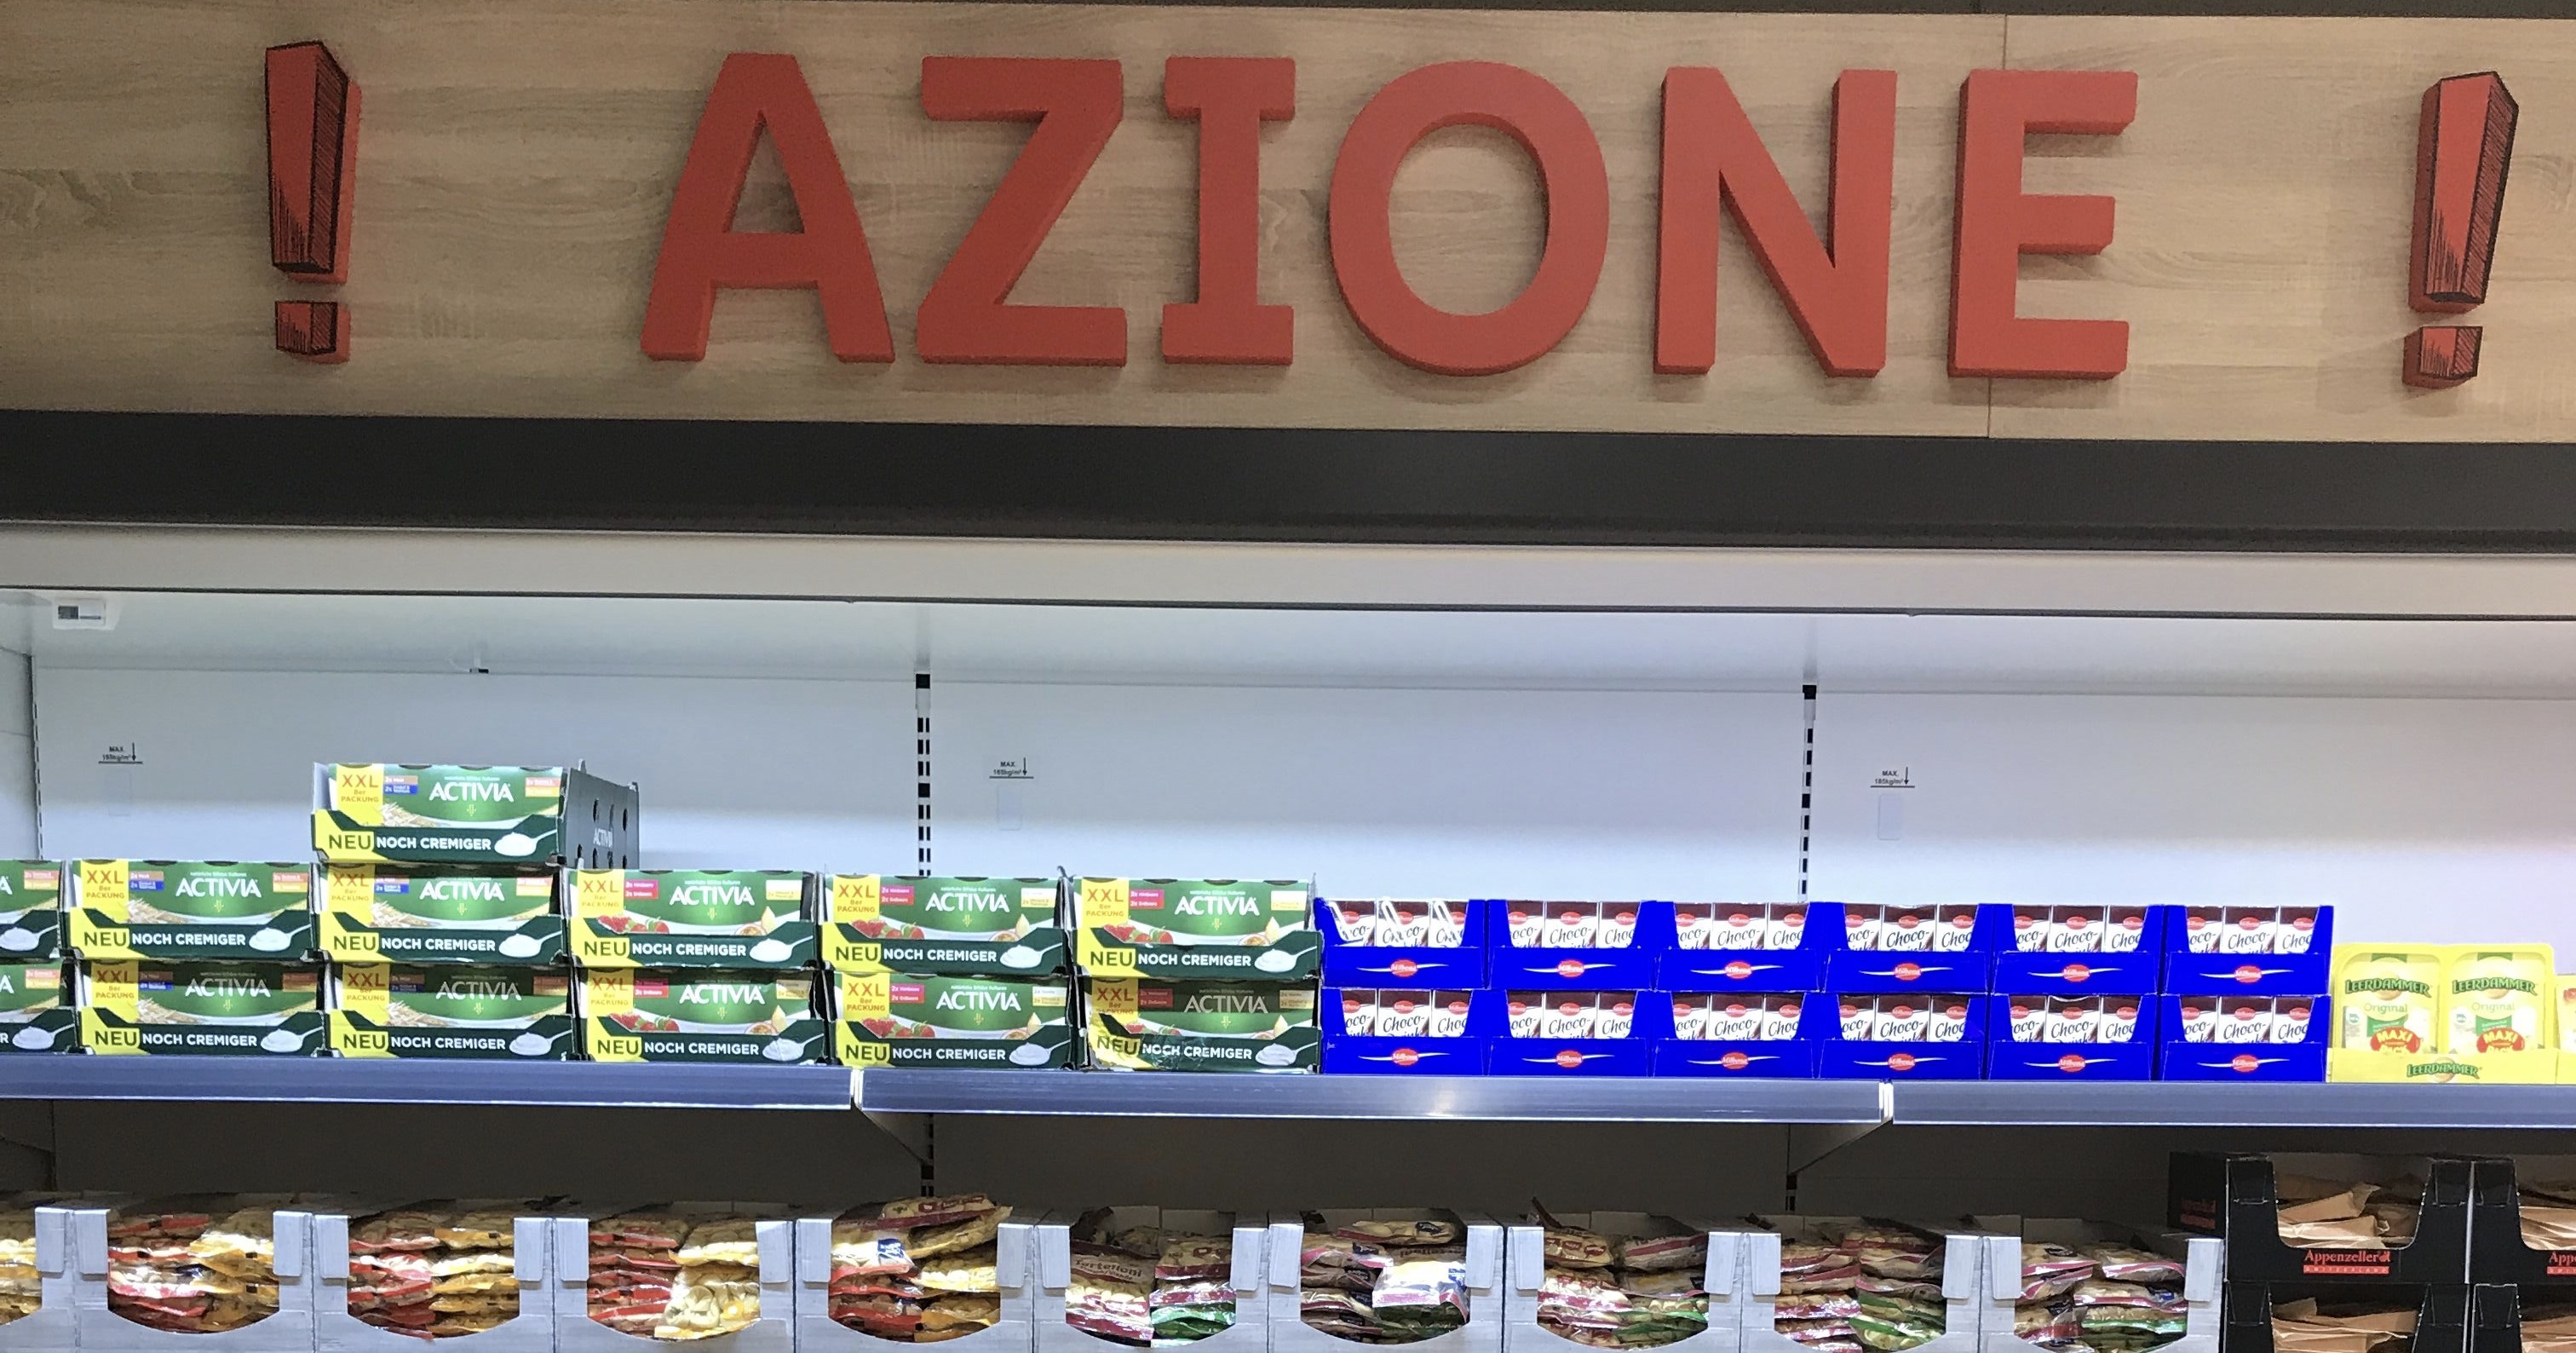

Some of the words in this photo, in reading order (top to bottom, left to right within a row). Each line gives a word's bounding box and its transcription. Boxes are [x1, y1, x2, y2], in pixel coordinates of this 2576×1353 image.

[640, 53, 2137, 378] AZIONE
[342, 774, 378, 788] XXL
[429, 782, 514, 803] ACTIVIA
[329, 835, 371, 849] NEU
[377, 838, 417, 849] NOCH
[421, 838, 492, 850] CREMIGER
[87, 871, 124, 884] XXL
[333, 874, 369, 887] XXL
[175, 878, 262, 898] ACTIVIA
[420, 881, 504, 901] ACTIVIA
[584, 880, 619, 893] XXL
[838, 884, 875, 897] XXL
[670, 886, 755, 906] ACTIVIA
[925, 893, 1009, 913] ACTIVIA
[1087, 889, 1124, 901] XXL
[1175, 896, 1259, 916] ACTIVIA
[84, 931, 126, 947] NEU
[133, 934, 172, 945] NOCH
[175, 934, 245, 946] CREMIGER
[1512, 926, 1538, 940] oco-
[1550, 927, 1592, 944] Choco-
[1605, 929, 1634, 944] Choc
[1679, 928, 1705, 942] oco-
[1717, 929, 1760, 946] Choco-
[1773, 930, 1802, 947] Choc
[1849, 930, 1874, 942] oco-
[1886, 930, 1929, 947] Choco-
[1941, 931, 1971, 947] Choc
[2017, 930, 2044, 944] oco-
[2055, 931, 2097, 948] Choco-
[2112, 932, 2139, 949] Choc
[2189, 932, 2216, 945] oco-
[2228, 932, 2269, 949] Choco-
[334, 936, 376, 951] NEU
[382, 938, 421, 949] NOCH
[425, 939, 495, 951] CREMIGER
[584, 941, 626, 956] NEU
[632, 943, 672, 955] NOCH
[676, 944, 746, 956] CREMIGER
[2282, 934, 2310, 949] Choc
[836, 947, 877, 961] NEU
[883, 949, 923, 960] NOCH
[928, 949, 997, 962] CREMIGER
[1090, 952, 1132, 966] NEU
[1138, 953, 1178, 965] NOCH
[1182, 954, 1251, 966] CREMIGER
[97, 970, 134, 983] XXL
[348, 973, 385, 987] XXL
[592, 977, 628, 991] XXL
[185, 979, 271, 997] ACTIVIA
[436, 981, 521, 1000] ACTIVIA
[680, 984, 765, 1004] ACTIVIA
[848, 983, 885, 996] XXL
[1096, 988, 1135, 1001] XXL
[2345, 978, 2431, 998] LEERDAMMER
[2452, 977, 2538, 996] LEERDAMMER
[936, 991, 1021, 1010] ACTIVIA
[1184, 995, 1268, 1013] ACTIVIA
[2472, 1003, 2515, 1013] Original
[2364, 1004, 2407, 1014] Original
[1346, 1014, 1371, 1027] oco-
[1383, 1015, 1424, 1031] Choco-
[1438, 1017, 1466, 1033] Choc
[1511, 1017, 1537, 1030] oco-
[1549, 1018, 1590, 1034] Choco-
[1602, 1019, 1631, 1034] Choc
[1676, 1018, 1702, 1032] oco-
[1715, 1019, 1757, 1036] Choco-
[1843, 1020, 1867, 1033] oco-
[2014, 1021, 2039, 1033] oco-
[2185, 1022, 2211, 1035] oco-
[1768, 1021, 1798, 1037] Choc
[1880, 1021, 1923, 1038] Choco-
[1935, 1022, 1964, 1038] Choc
[2051, 1021, 2094, 1039] Choco-
[2105, 1022, 2135, 1039] Choc
[2223, 1022, 2266, 1039] Choco-
[2278, 1022, 2308, 1039] Choc
[2377, 1029, 2412, 1042] MAXI
[2482, 1030, 2517, 1042] MAXI
[95, 1031, 136, 1045] NEU
[143, 1033, 182, 1045] NOCH
[187, 1034, 257, 1046] CREMIGER
[343, 1033, 385, 1049] NEU
[391, 1037, 430, 1047] NOCH
[435, 1037, 505, 1050] CREMIGER
[598, 1040, 638, 1054] NEU
[645, 1042, 684, 1053] NOCH
[689, 1042, 759, 1055] CREMIGER
[846, 1045, 887, 1061] NEU
[893, 1048, 932, 1059] NOCH
[936, 1049, 1006, 1060] CREMIGER
[1096, 1036, 1137, 1055] NEU
[1142, 1045, 1180, 1056] NOCH
[1183, 1046, 1252, 1060] CREMIGER
[2406, 1063, 2480, 1080] LEERDAMMER
[2305, 1251, 2378, 1263] Appenzeller
